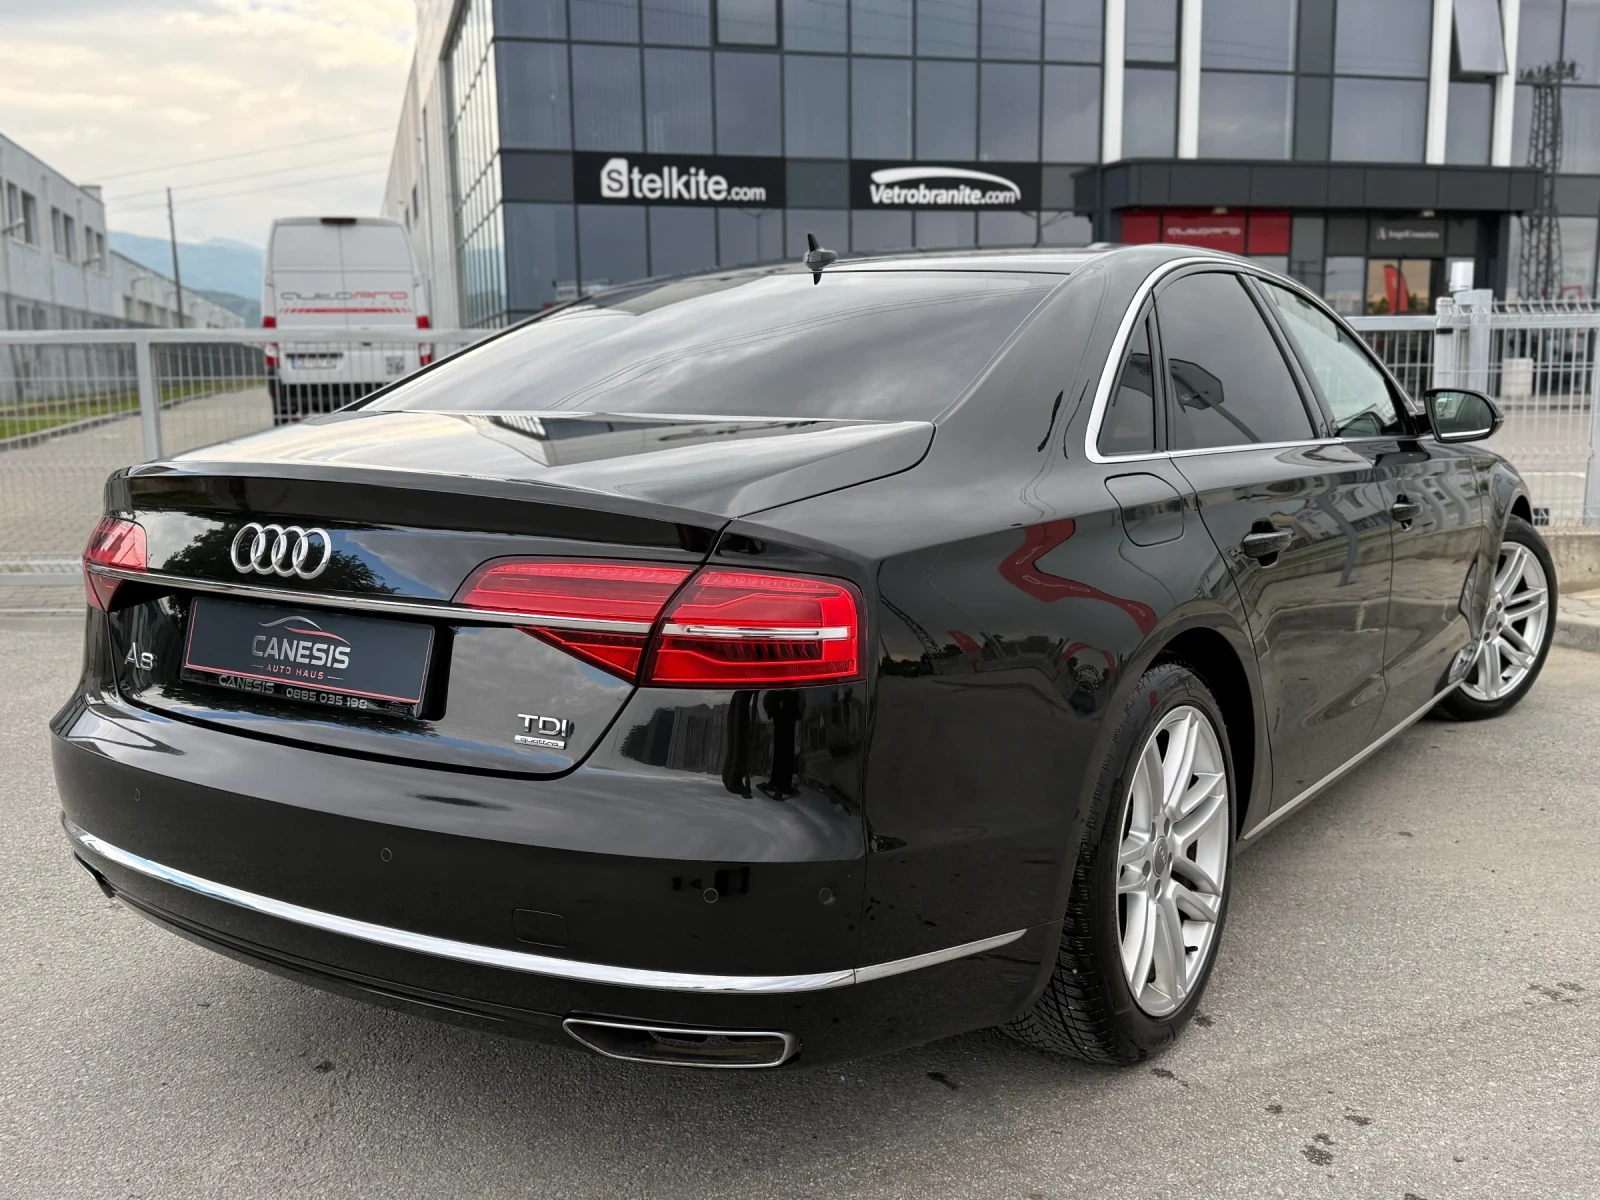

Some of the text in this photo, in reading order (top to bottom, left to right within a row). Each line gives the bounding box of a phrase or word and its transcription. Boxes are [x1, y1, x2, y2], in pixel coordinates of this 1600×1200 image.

[600, 157, 767, 202] Stelkite.com
[869, 183, 1016, 205] Vetrobranite.com
[124, 642, 154, 671] A8
[251, 634, 351, 669] CANESIS
[266, 664, 324, 680] AUTO HAUS
[218, 673, 275, 694] CANESIS
[286, 687, 316, 701] 0885
[319, 693, 343, 706] 035
[346, 697, 368, 709] 198
[517, 713, 568, 737] TDI
